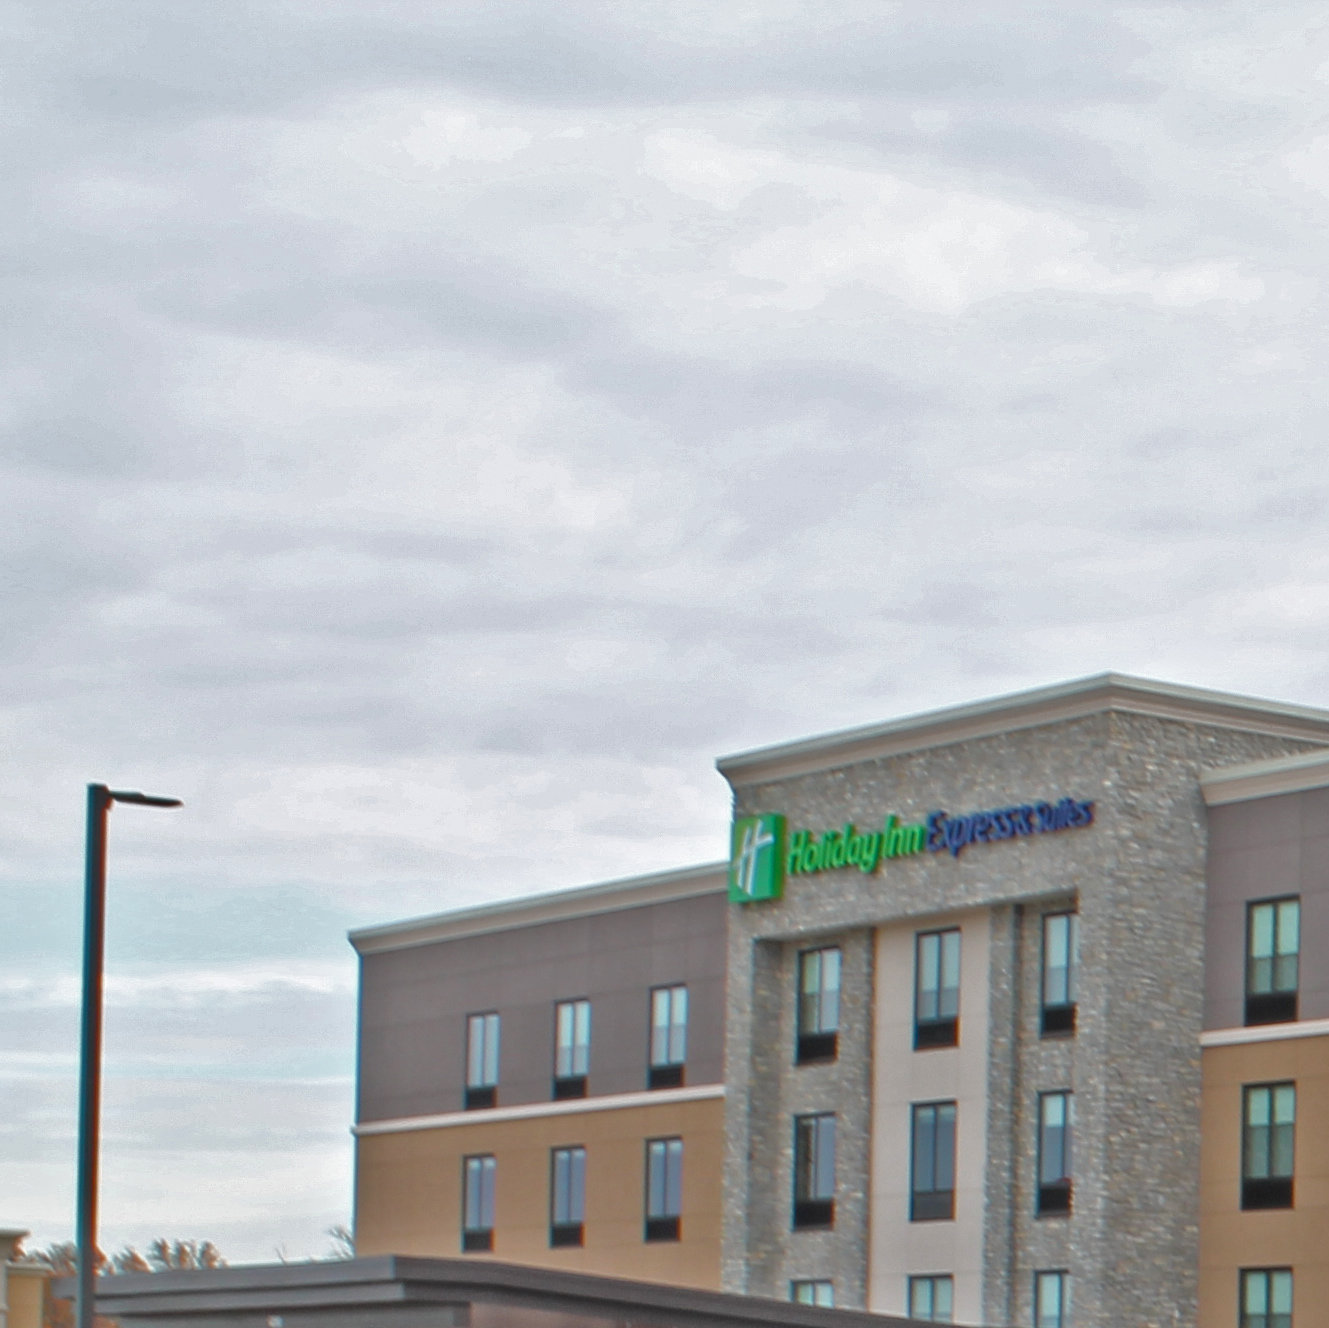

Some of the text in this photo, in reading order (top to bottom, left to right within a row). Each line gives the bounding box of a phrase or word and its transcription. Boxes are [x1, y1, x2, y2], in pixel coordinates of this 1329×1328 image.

[787, 823, 882, 876] Holiday
[882, 814, 926, 859] Inn
[926, 810, 1015, 858] Express
